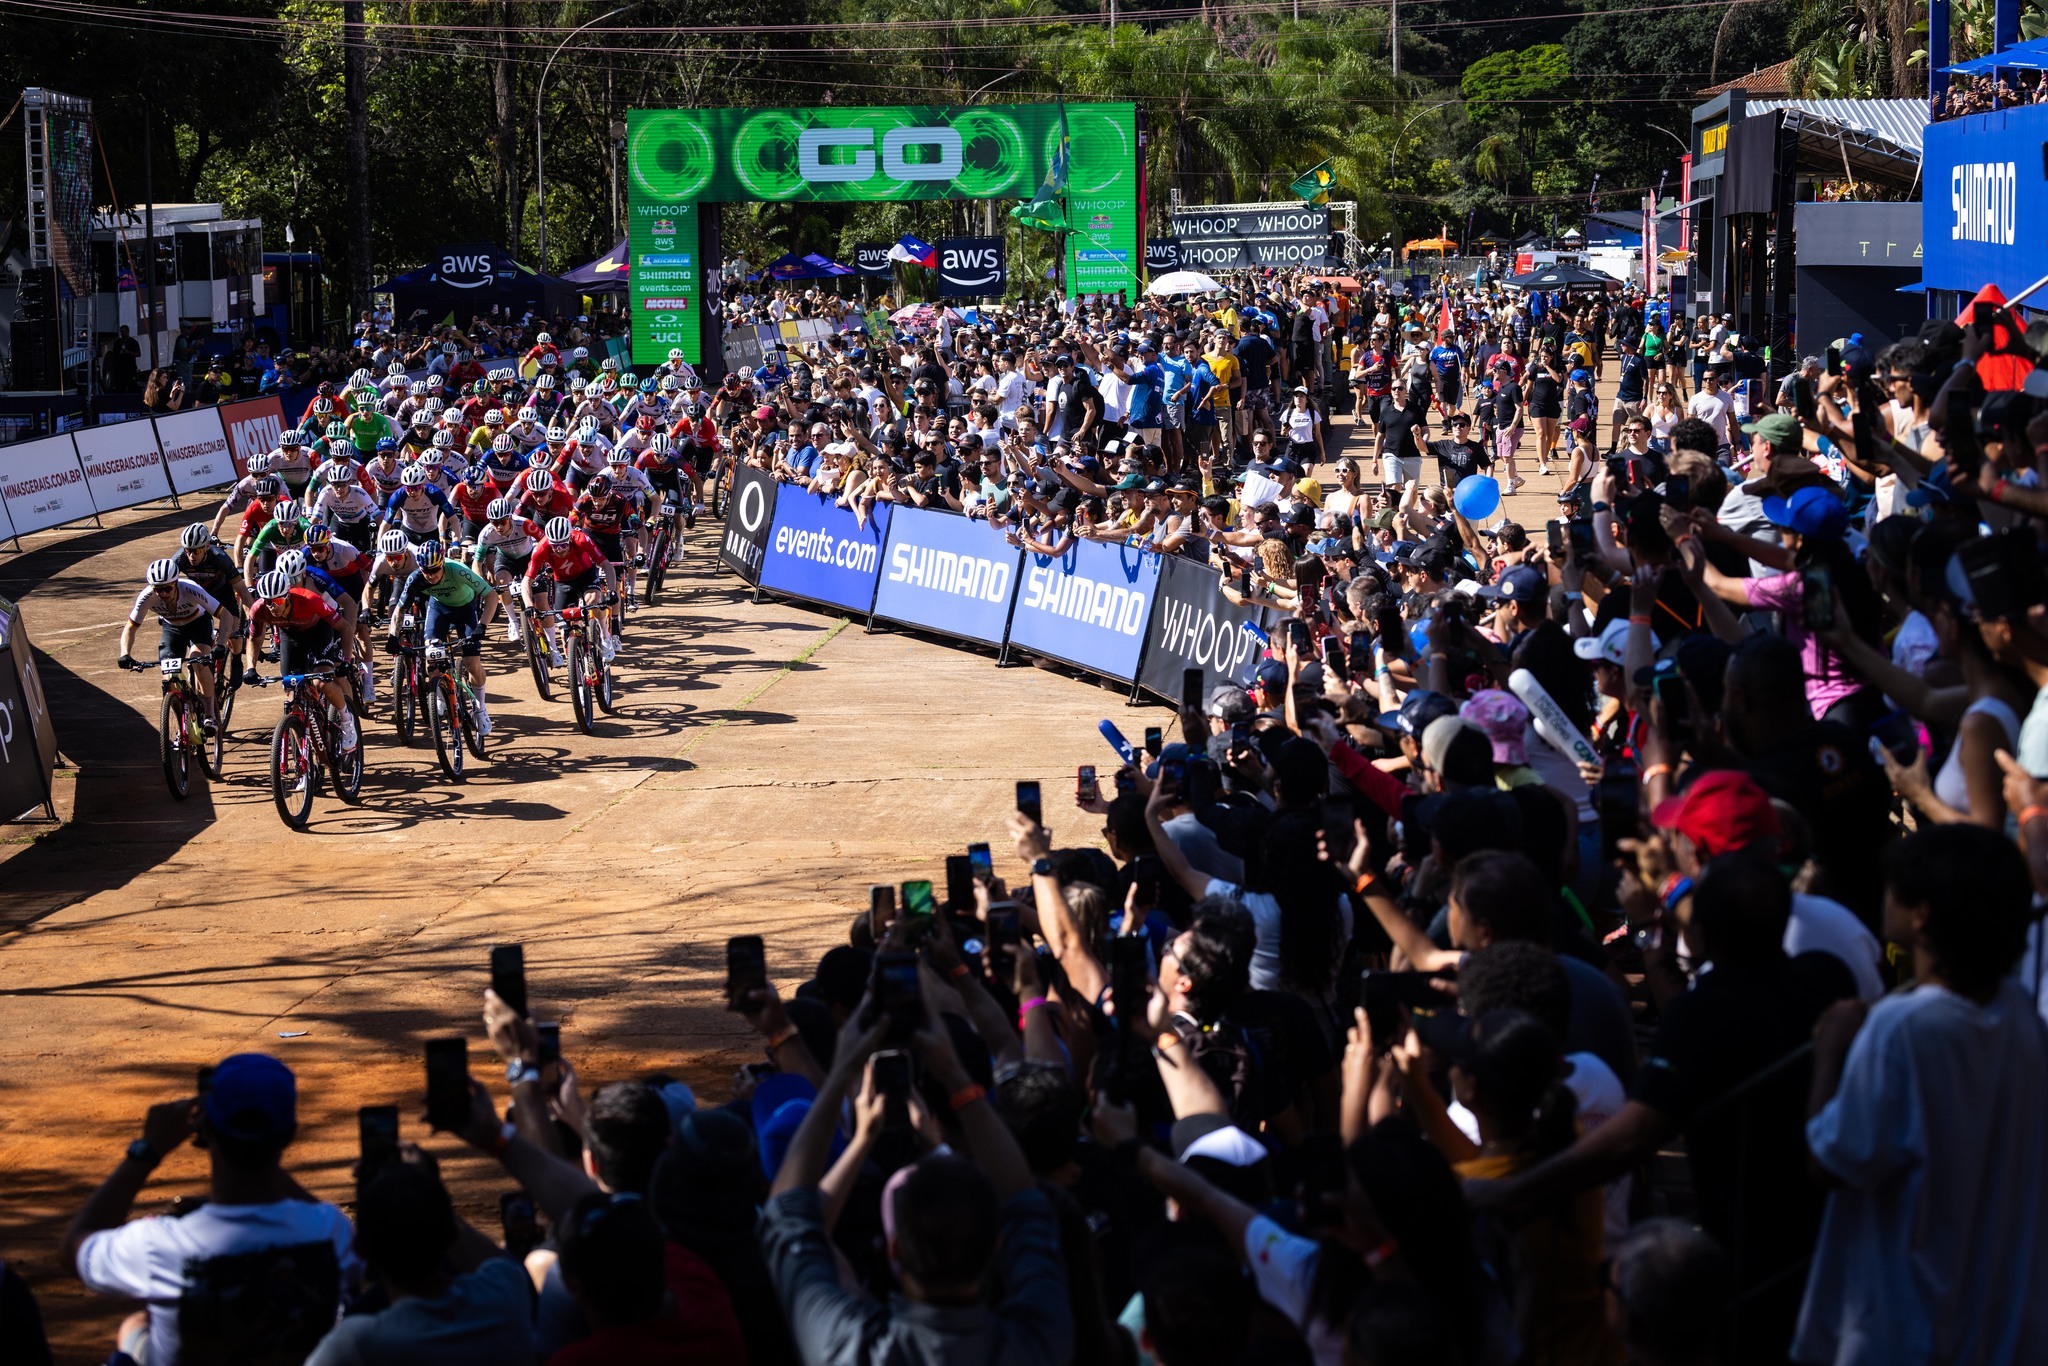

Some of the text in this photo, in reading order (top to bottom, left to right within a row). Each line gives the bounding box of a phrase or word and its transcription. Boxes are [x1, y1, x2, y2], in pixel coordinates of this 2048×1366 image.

[799, 127, 962, 182] GO
[638, 205, 689, 216] WHOOP
[1074, 200, 1127, 210] WHOOP
[1952, 162, 2016, 245] SHIMANO
[1173, 217, 1239, 236] WHOOP
[1258, 214, 1327, 232] WHOOP
[859, 250, 889, 262] aws
[943, 248, 998, 269] aws
[1147, 244, 1176, 258] aws
[1259, 244, 1327, 262] WHOOP
[442, 254, 491, 273] aws
[1076, 266, 1127, 274] SHIMANO
[639, 271, 691, 280] SHIMANO
[639, 284, 691, 292] events.com
[646, 299, 685, 309] MOTUL
[656, 333, 681, 343] UCI
[230, 414, 282, 460] MOTUL
[166, 438, 226, 463] MINASGERAIS.COM.BR
[86, 451, 160, 479] MINASGERAIS.COM.BR
[3, 468, 82, 500] MINASGERAIS.COM.BR
[726, 529, 762, 569] OAKLEY
[775, 525, 877, 574] events.com
[888, 542, 1010, 603] SHIMANO
[1024, 565, 1145, 637] SHIMANO
[1164, 596, 1249, 679] WHOOP
[165, 660, 179, 668] 12
